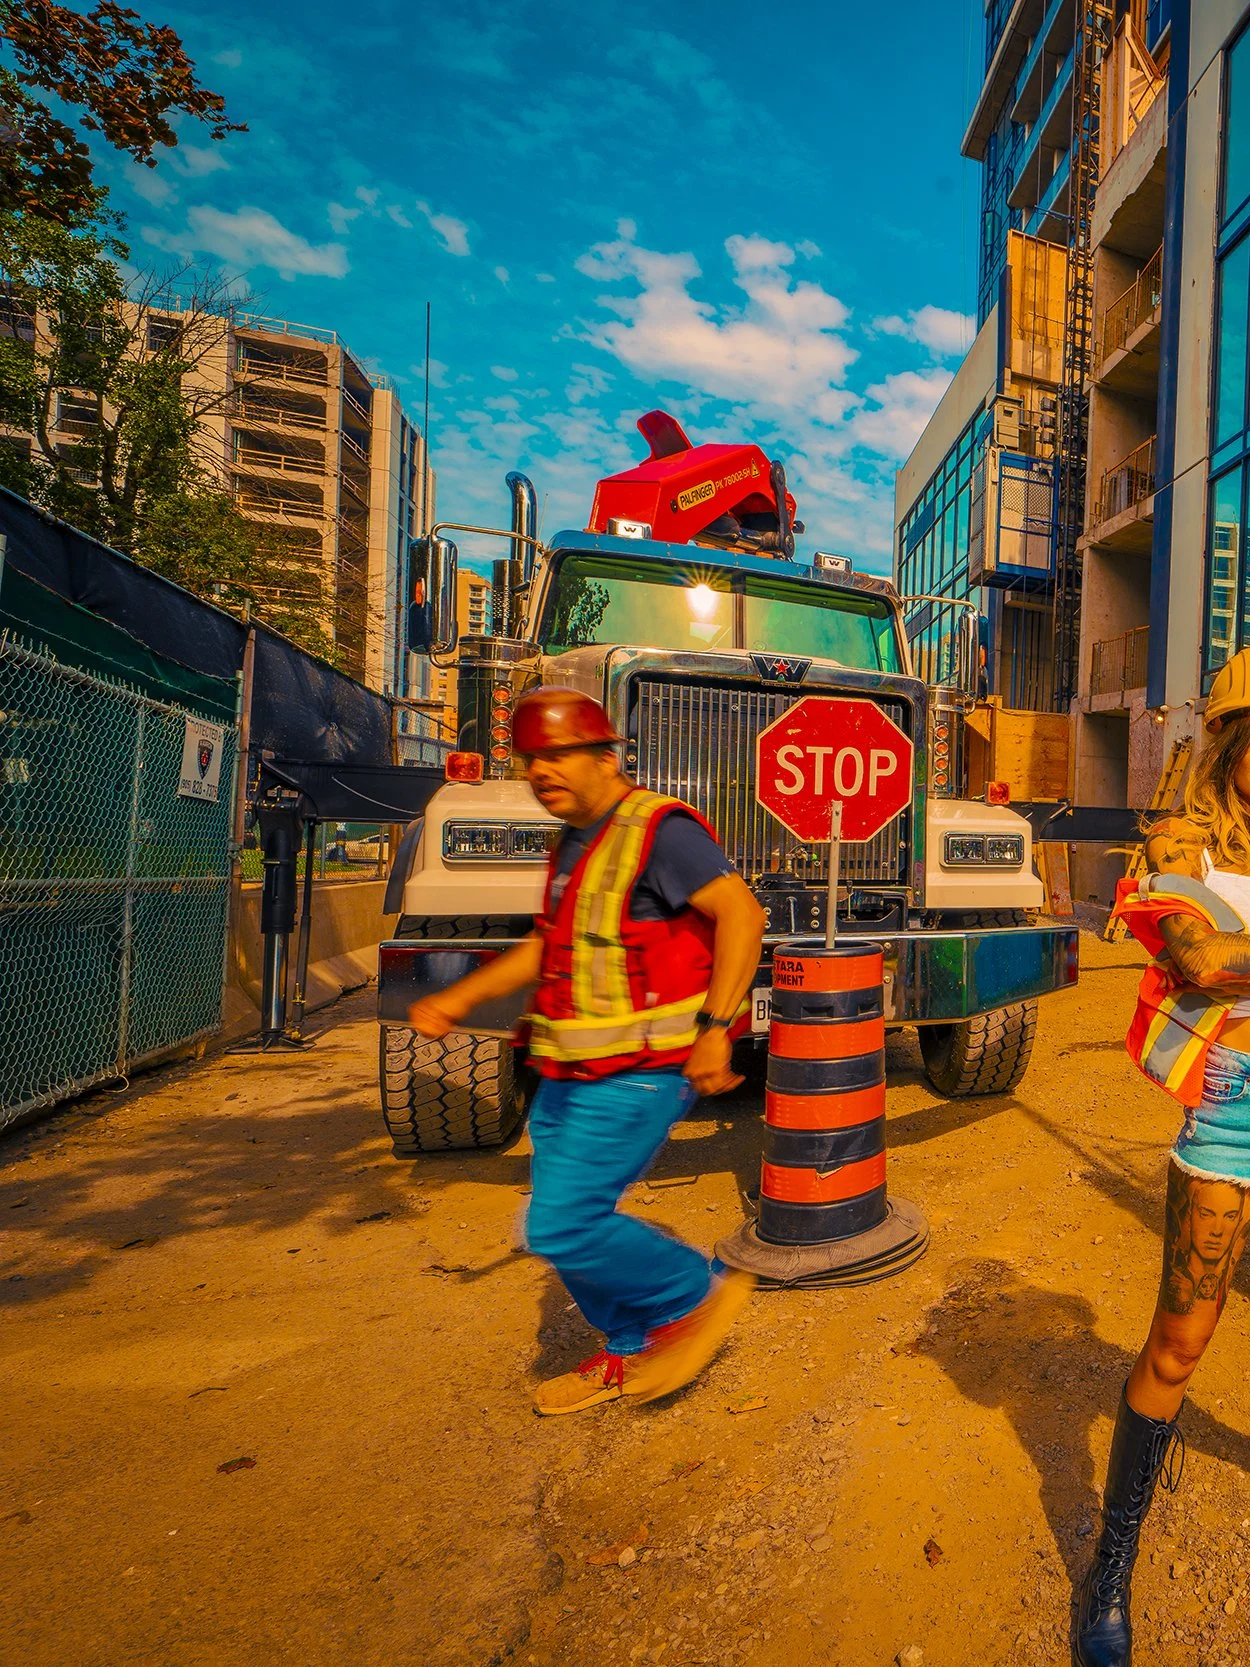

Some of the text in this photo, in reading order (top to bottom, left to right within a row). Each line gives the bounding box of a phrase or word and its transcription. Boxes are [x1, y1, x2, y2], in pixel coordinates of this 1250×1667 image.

[679, 483, 714, 508] PALFINGER
[715, 480, 724, 490] PK
[186, 718, 218, 741] OTECTED
[774, 744, 898, 797] STOP
